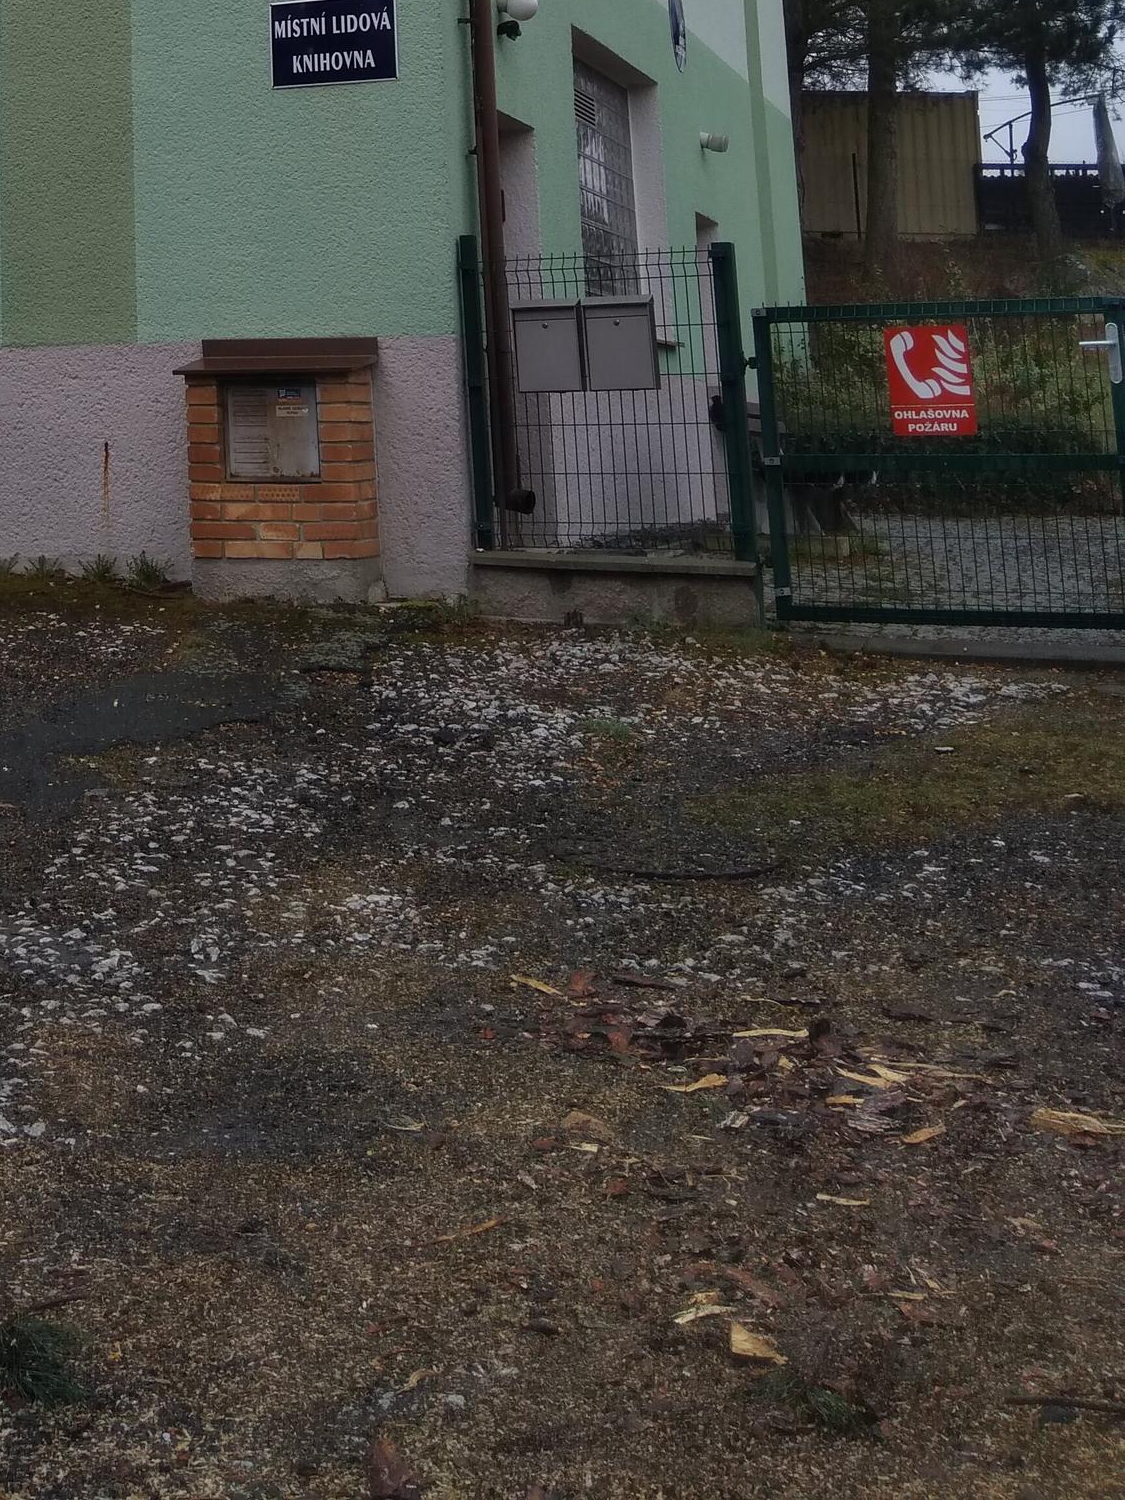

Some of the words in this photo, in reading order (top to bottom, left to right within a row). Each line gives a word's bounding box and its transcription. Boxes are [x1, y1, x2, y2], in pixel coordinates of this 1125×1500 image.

[274, 11, 326, 39] MÍSTNÍ
[332, 6, 392, 34] LIDOVÁ
[292, 49, 376, 74] KNIHOVNA
[894, 408, 969, 420] OHLAŠOVNA
[908, 421, 958, 432] POŽÁRU
